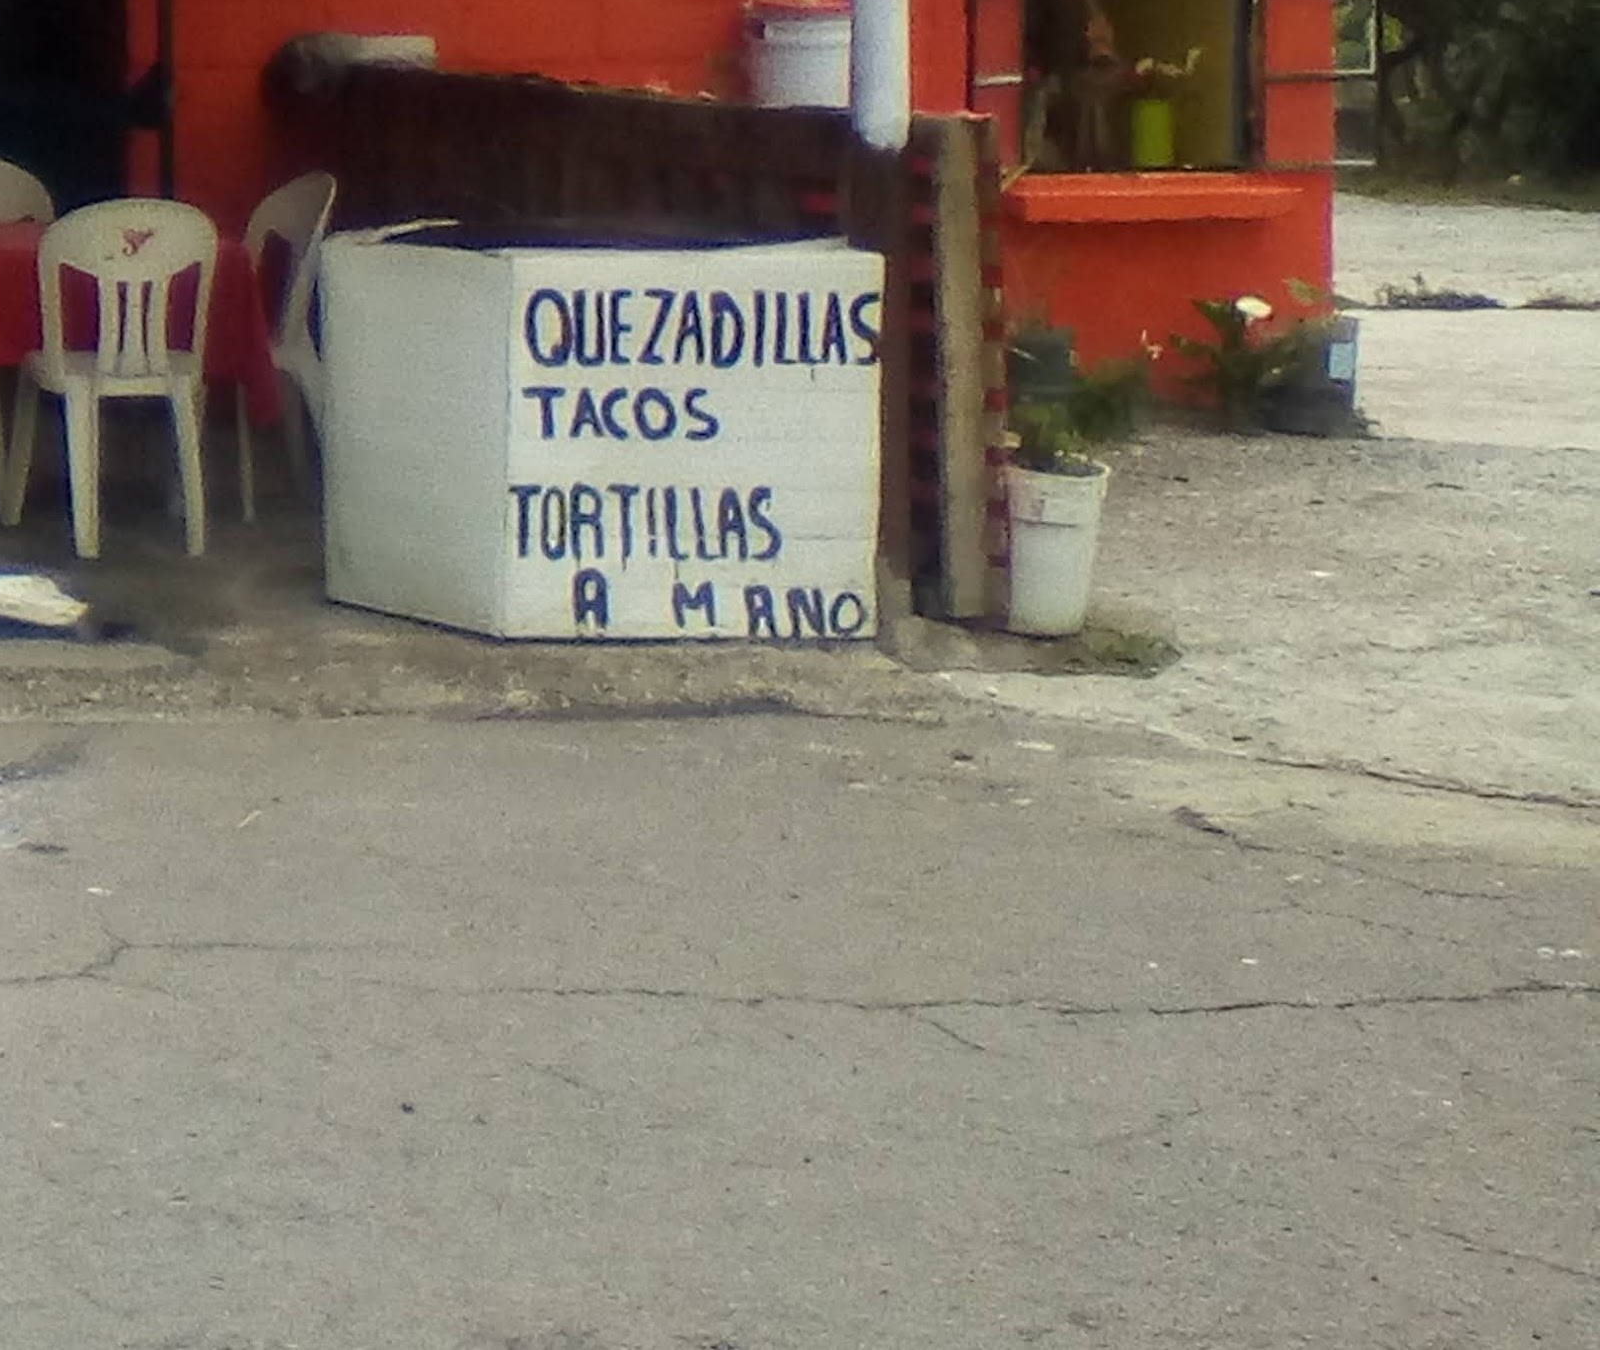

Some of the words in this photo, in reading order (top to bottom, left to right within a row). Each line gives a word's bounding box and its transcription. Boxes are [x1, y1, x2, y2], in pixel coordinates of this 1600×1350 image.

[523, 288, 883, 369] QUEZADILLAS
[522, 387, 720, 441] TACOS
[508, 483, 783, 562] TORTILLAS
[573, 567, 609, 630] A
